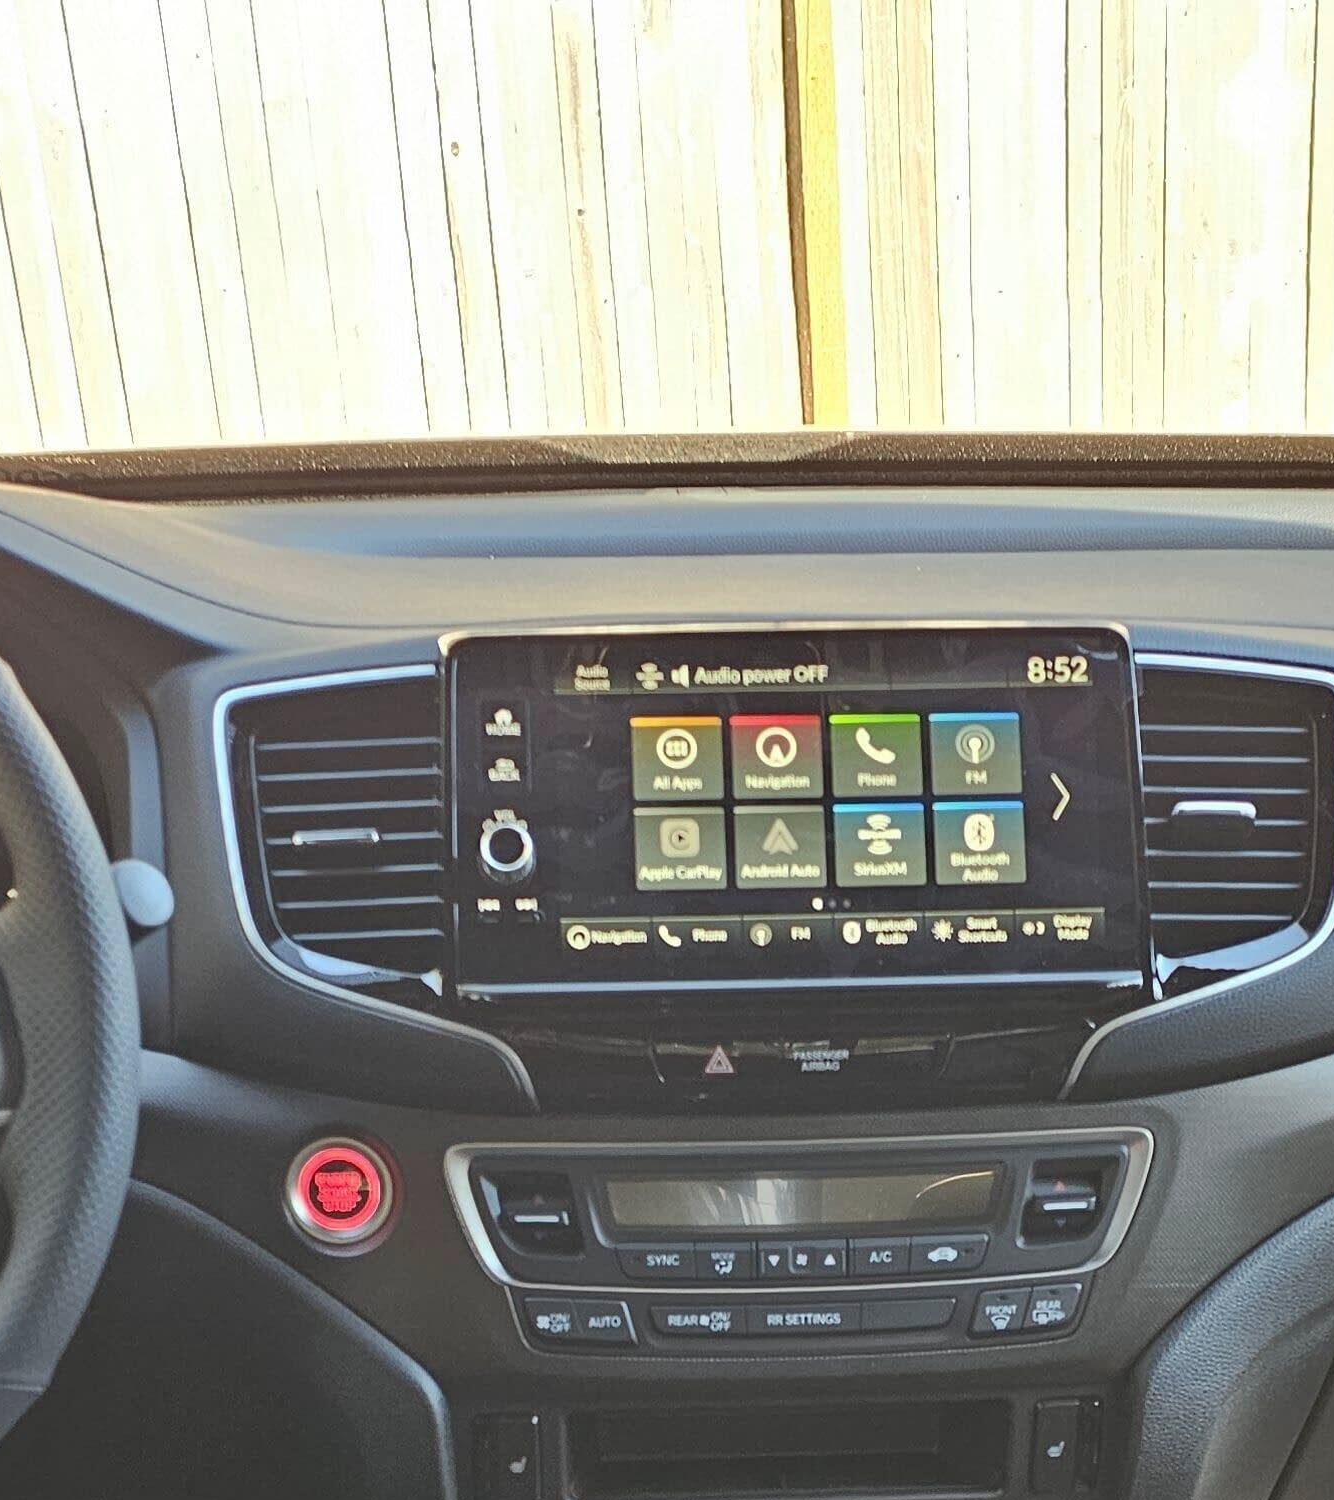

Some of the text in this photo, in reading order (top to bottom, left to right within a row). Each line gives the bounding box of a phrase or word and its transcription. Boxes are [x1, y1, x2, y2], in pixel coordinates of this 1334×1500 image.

[694, 664, 829, 686] Audio power OFF
[1027, 656, 1088, 684] 8:52
[653, 775, 703, 793] All Apps
[745, 773, 811, 791] Navigation
[857, 772, 897, 787] Phone
[965, 770, 987, 785] FM
[639, 865, 722, 882] Apple CarPlay
[741, 863, 821, 880] Android Auto
[854, 862, 908, 878] SiriusXM
[962, 867, 999, 883] Audio
[791, 926, 812, 941] FM
[646, 1254, 680, 1266] SYNC
[869, 1250, 893, 1264] A/C
[985, 1305, 1017, 1316] FRONT
[588, 1316, 621, 1328] AUTO
[667, 1314, 698, 1327] REAR
[767, 1313, 841, 1326] RR SETTINGS
